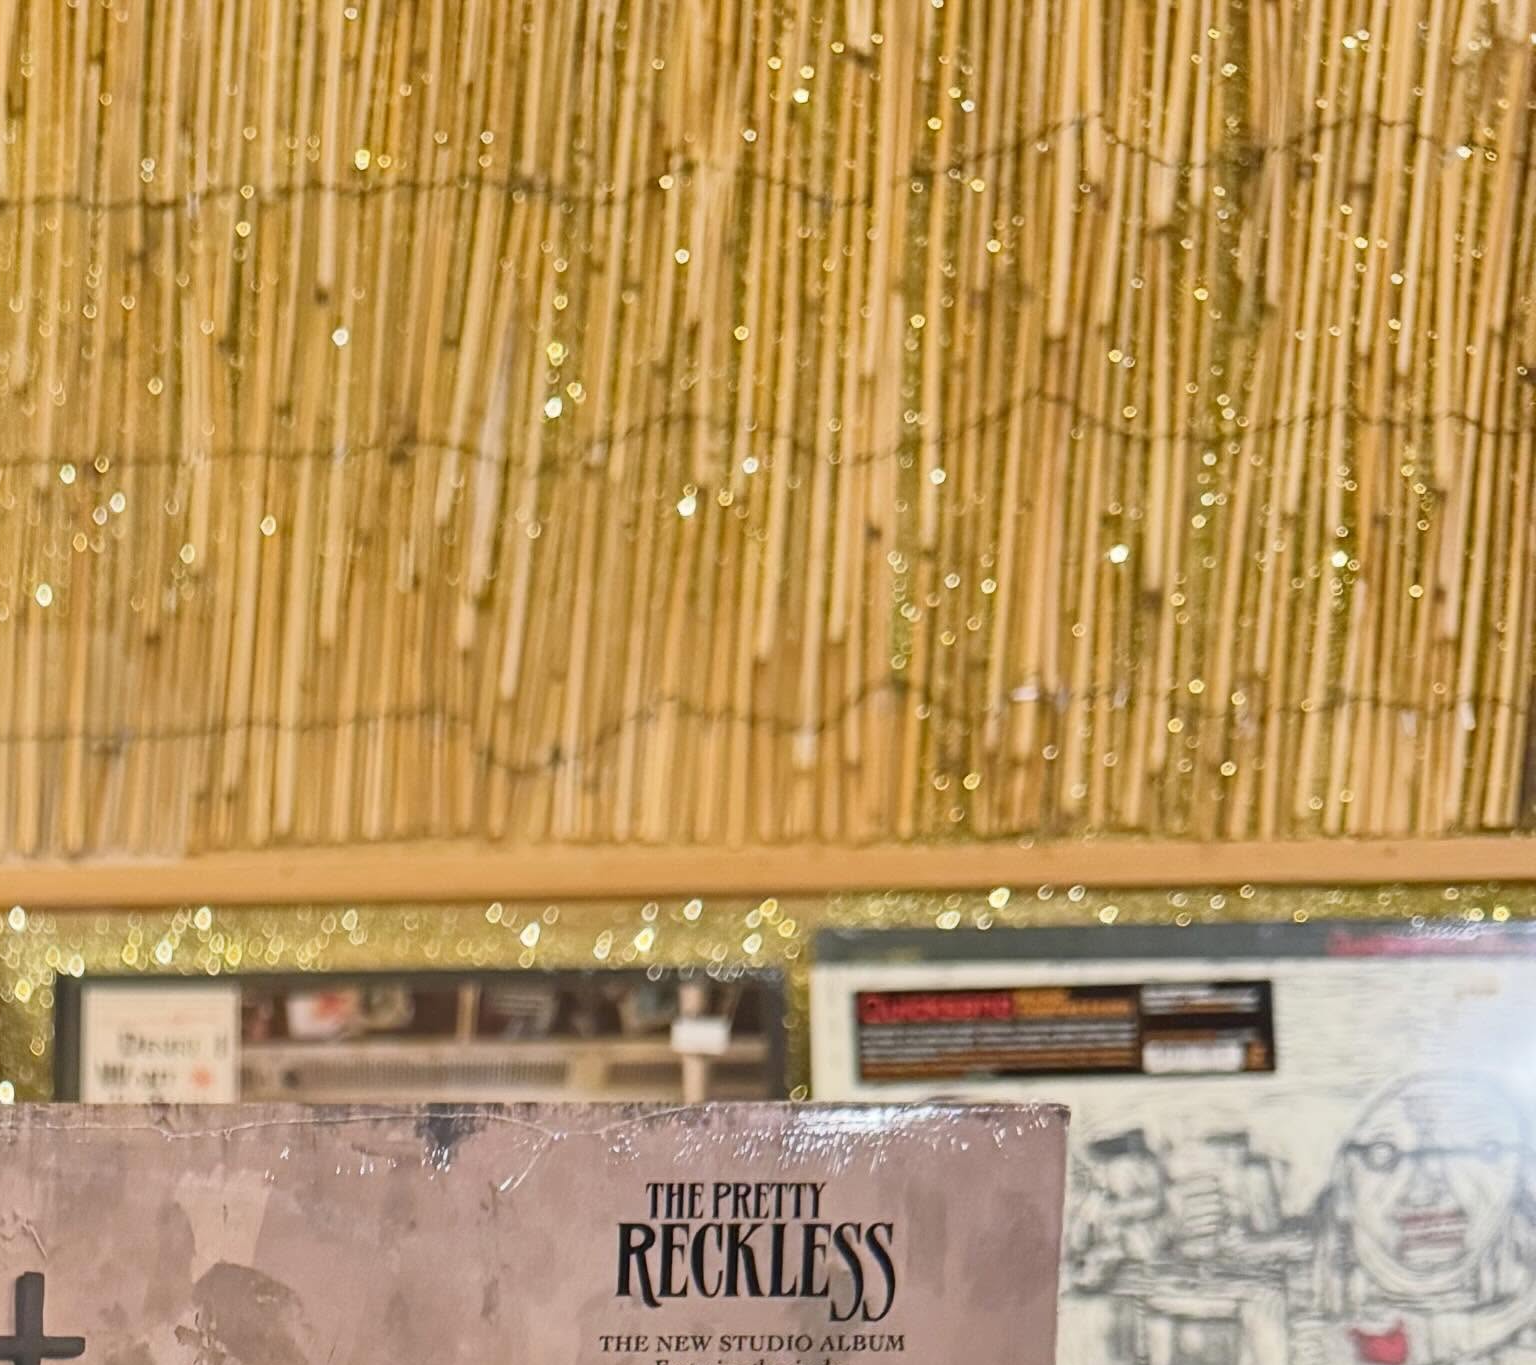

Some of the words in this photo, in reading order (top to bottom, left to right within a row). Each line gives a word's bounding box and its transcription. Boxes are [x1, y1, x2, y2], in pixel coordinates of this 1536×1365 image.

[646, 1182, 704, 1219] THE
[712, 1182, 826, 1219] PRETTY
[616, 1222, 895, 1322] RECKLESS
[599, 1335, 648, 1352] THE
[656, 1335, 712, 1352] NEW
[719, 1334, 813, 1352] STUDIO
[820, 1334, 905, 1352] ALBUM
